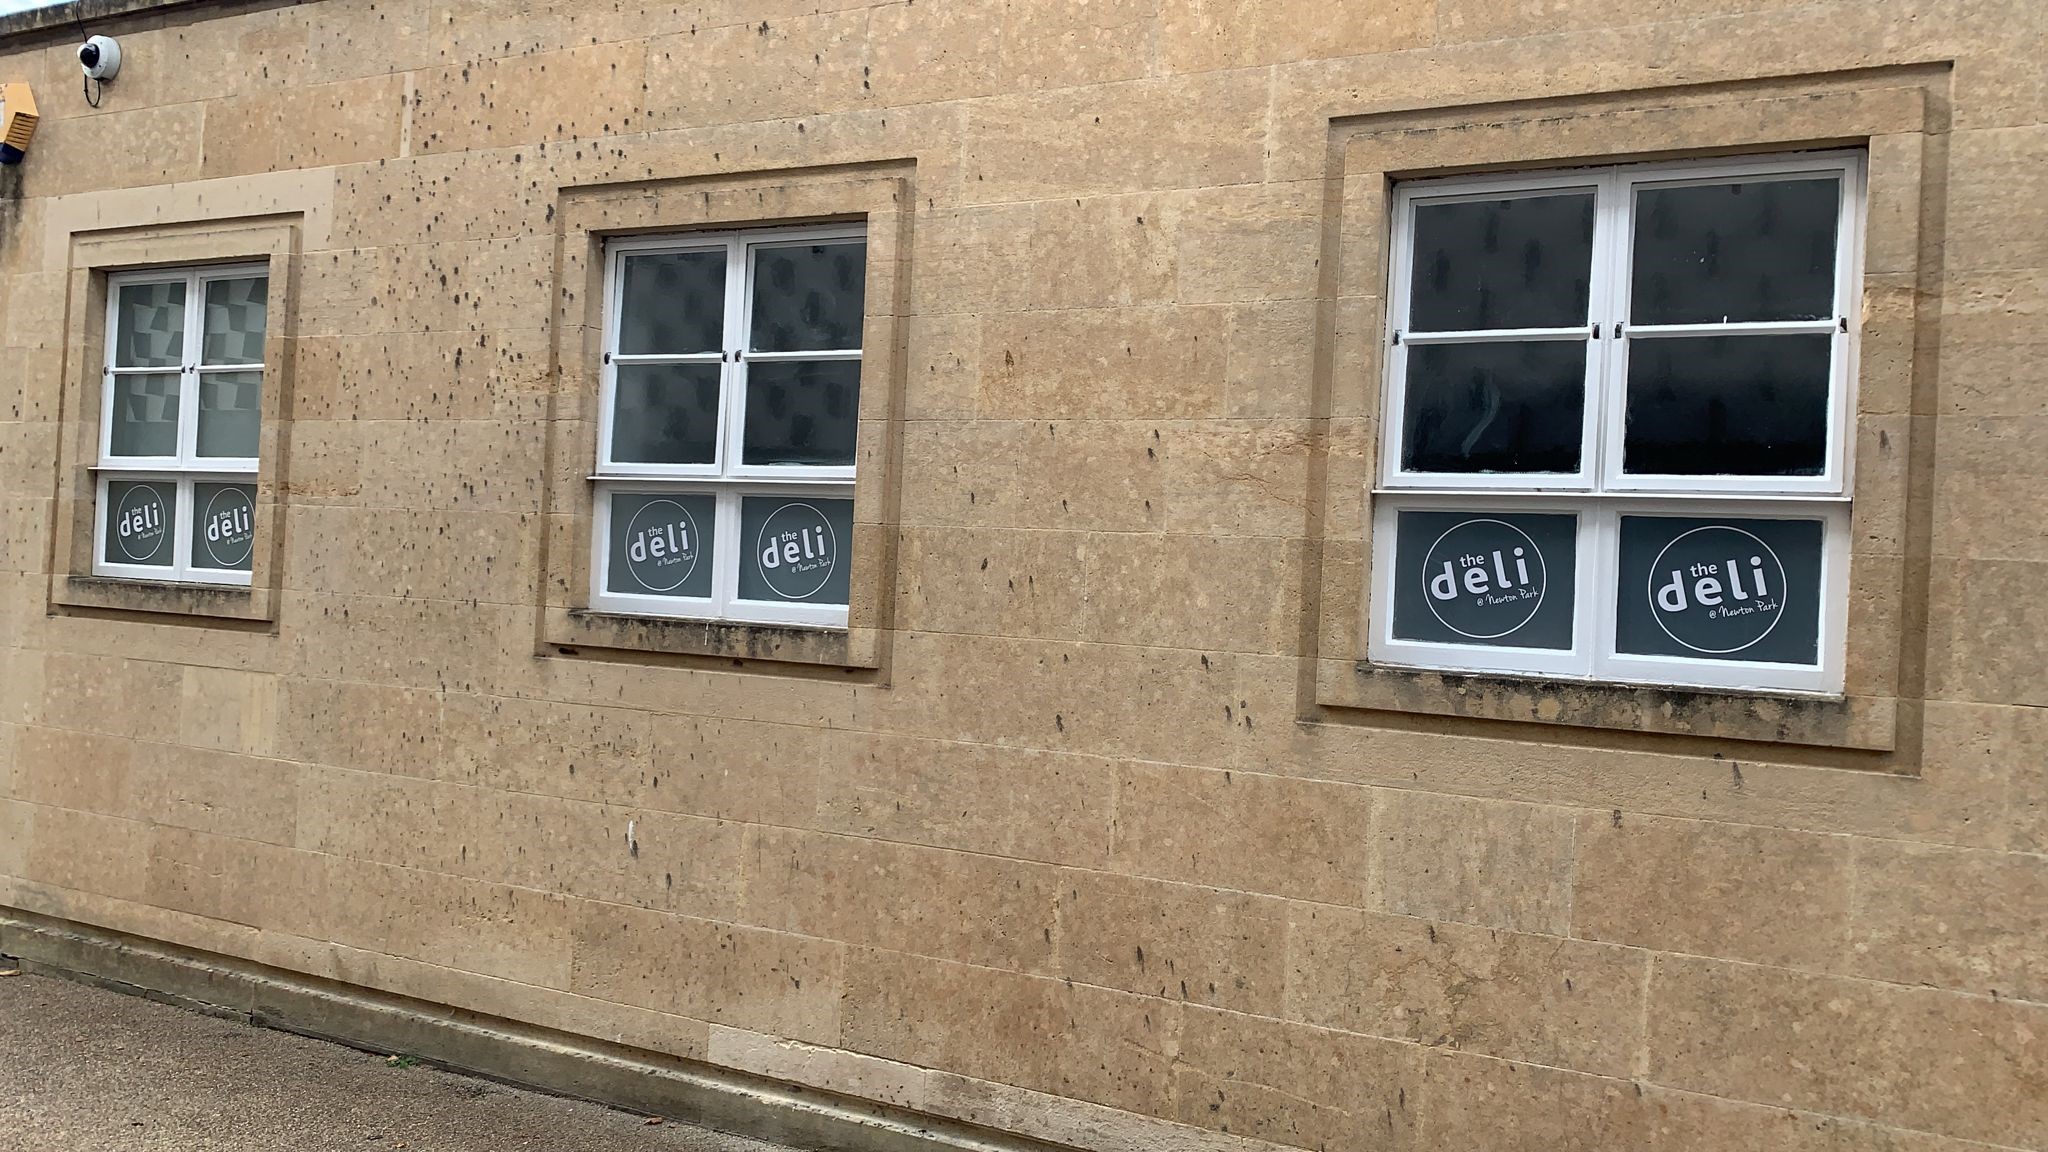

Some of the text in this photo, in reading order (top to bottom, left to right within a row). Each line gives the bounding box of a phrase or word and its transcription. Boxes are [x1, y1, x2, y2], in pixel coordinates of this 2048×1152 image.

[120, 503, 159, 537] deli
[132, 507, 142, 515] the
[220, 511, 231, 519] the
[208, 506, 249, 541] deli
[648, 526, 663, 537] the
[630, 521, 688, 562] deli
[781, 530, 797, 542] the
[763, 526, 825, 569] deli
[1460, 554, 1485, 568] the
[1690, 563, 1718, 577] the
[1431, 547, 1529, 600] deli
[1657, 556, 1767, 612] deli
[1477, 587, 1539, 606] @ Newton Park
[1709, 598, 1778, 619] @ Newton Park
